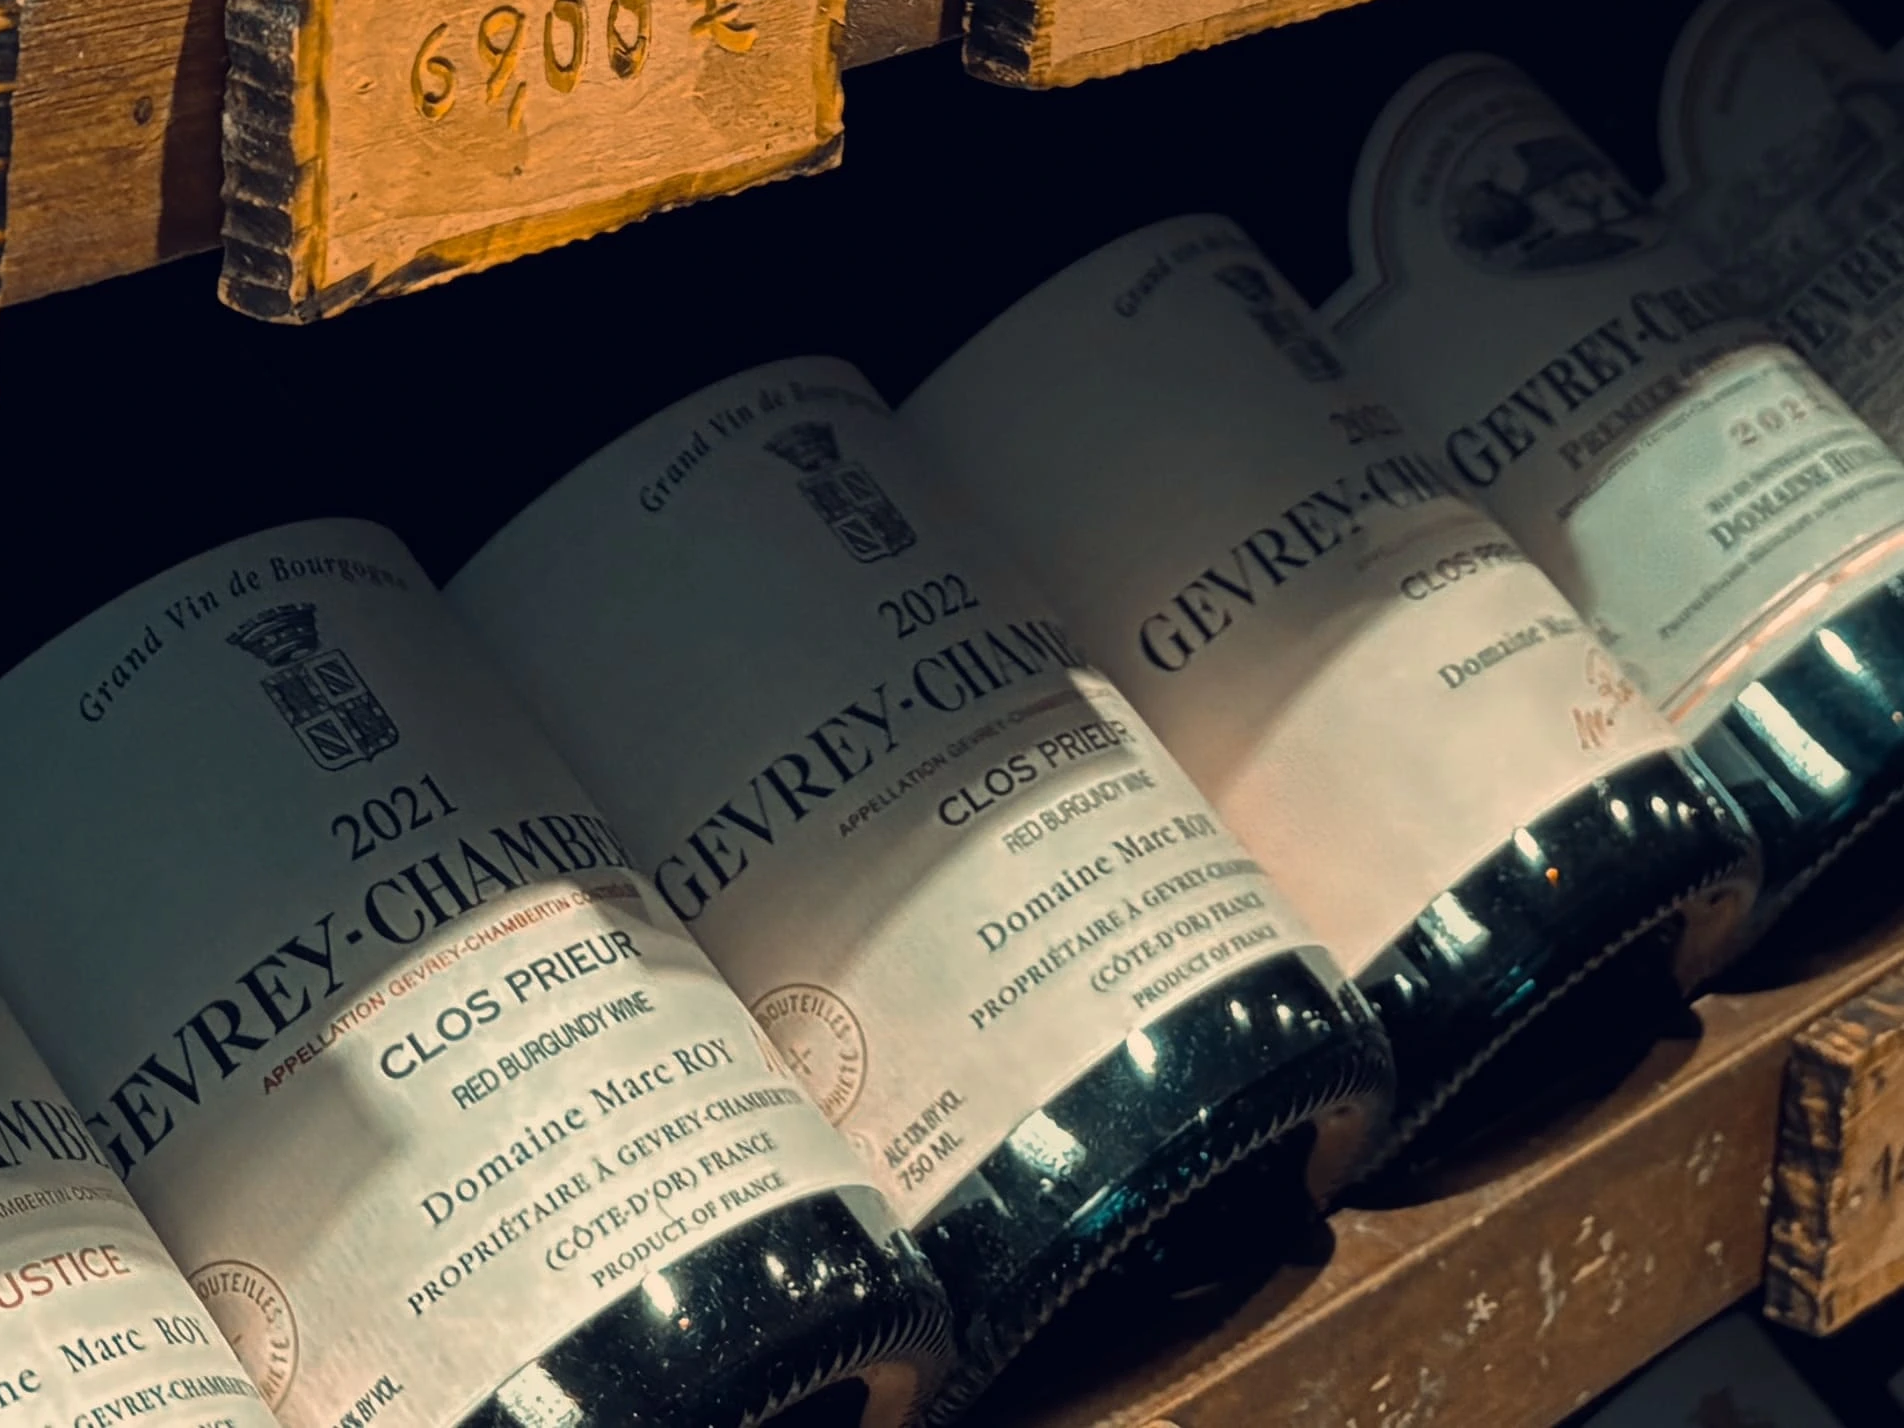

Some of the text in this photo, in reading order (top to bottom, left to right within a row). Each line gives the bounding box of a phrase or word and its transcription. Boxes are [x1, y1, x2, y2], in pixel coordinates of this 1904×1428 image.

[637, 430, 712, 515] Grand
[707, 397, 753, 435] Vin
[78, 625, 164, 726] Grand
[164, 593, 219, 633] Vin
[230, 562, 261, 598] de
[879, 574, 980, 642] 2022
[332, 774, 458, 861] 2021
[838, 754, 948, 839] APPELLATION
[937, 754, 1039, 828] CLOS
[1039, 720, 1137, 769] PRIEUR
[974, 851, 1115, 955] Domaine
[1111, 825, 1178, 866] Marc
[1002, 820, 1044, 855] RED
[261, 893, 571, 1095] APPELLATION GEVREY-CHAMBERTIN
[379, 930, 643, 1081] CLOS PRIEUR
[968, 911, 1124, 1031] PROPRIÉTAIRE
[1132, 949, 1213, 1009] PRODUCT
[451, 990, 656, 1111] RED BURGUNDY WINE
[421, 1037, 736, 1229] Domaine Marc ROY
[898, 1130, 965, 1191] 750 ML
[407, 1171, 593, 1317] PROPRIÉTAIRE
[595, 1154, 614, 1184] À
[545, 1129, 779, 1272] (CÔTE-D'OR) FRANCE
[590, 1169, 787, 1290] PRODUCT OF FRANCE
[61, 1322, 144, 1375] Marc
[153, 1313, 211, 1348] ROY
